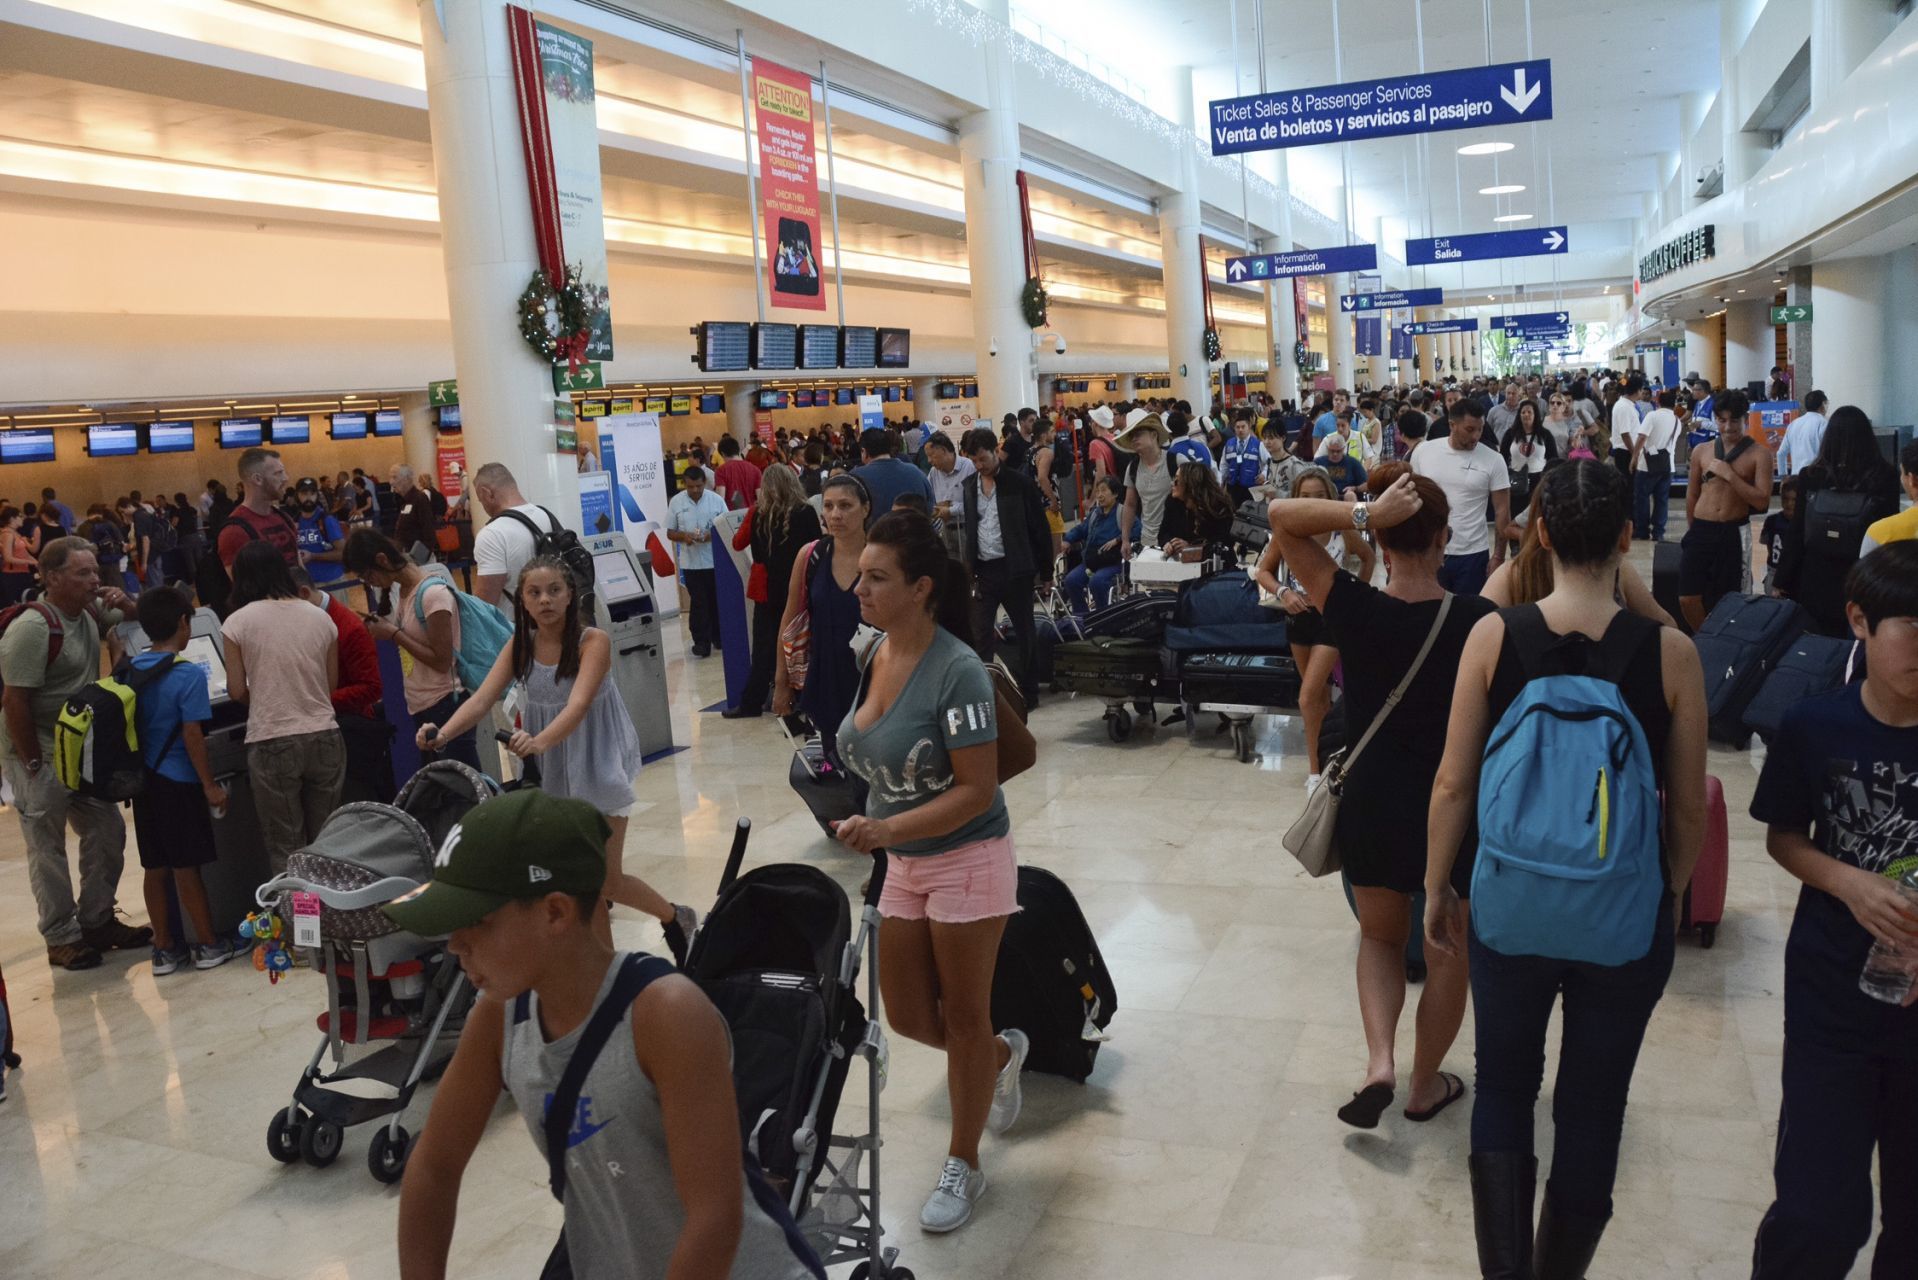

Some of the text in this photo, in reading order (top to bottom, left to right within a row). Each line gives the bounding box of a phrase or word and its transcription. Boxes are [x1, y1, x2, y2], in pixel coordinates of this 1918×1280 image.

[758, 82, 809, 110] ATTENTION!
[1214, 82, 1432, 122] Ticket Sales & Passenger Services
[1215, 98, 1493, 145] Venta de boletos y servicios al pasajero
[1434, 239, 1450, 249] Exit
[1669, 225, 1706, 269] COFFEE
[1274, 252, 1319, 265] Information
[1434, 248, 1462, 260] Salida
[1274, 261, 1326, 275] Información
[650, 461, 657, 470] DE
